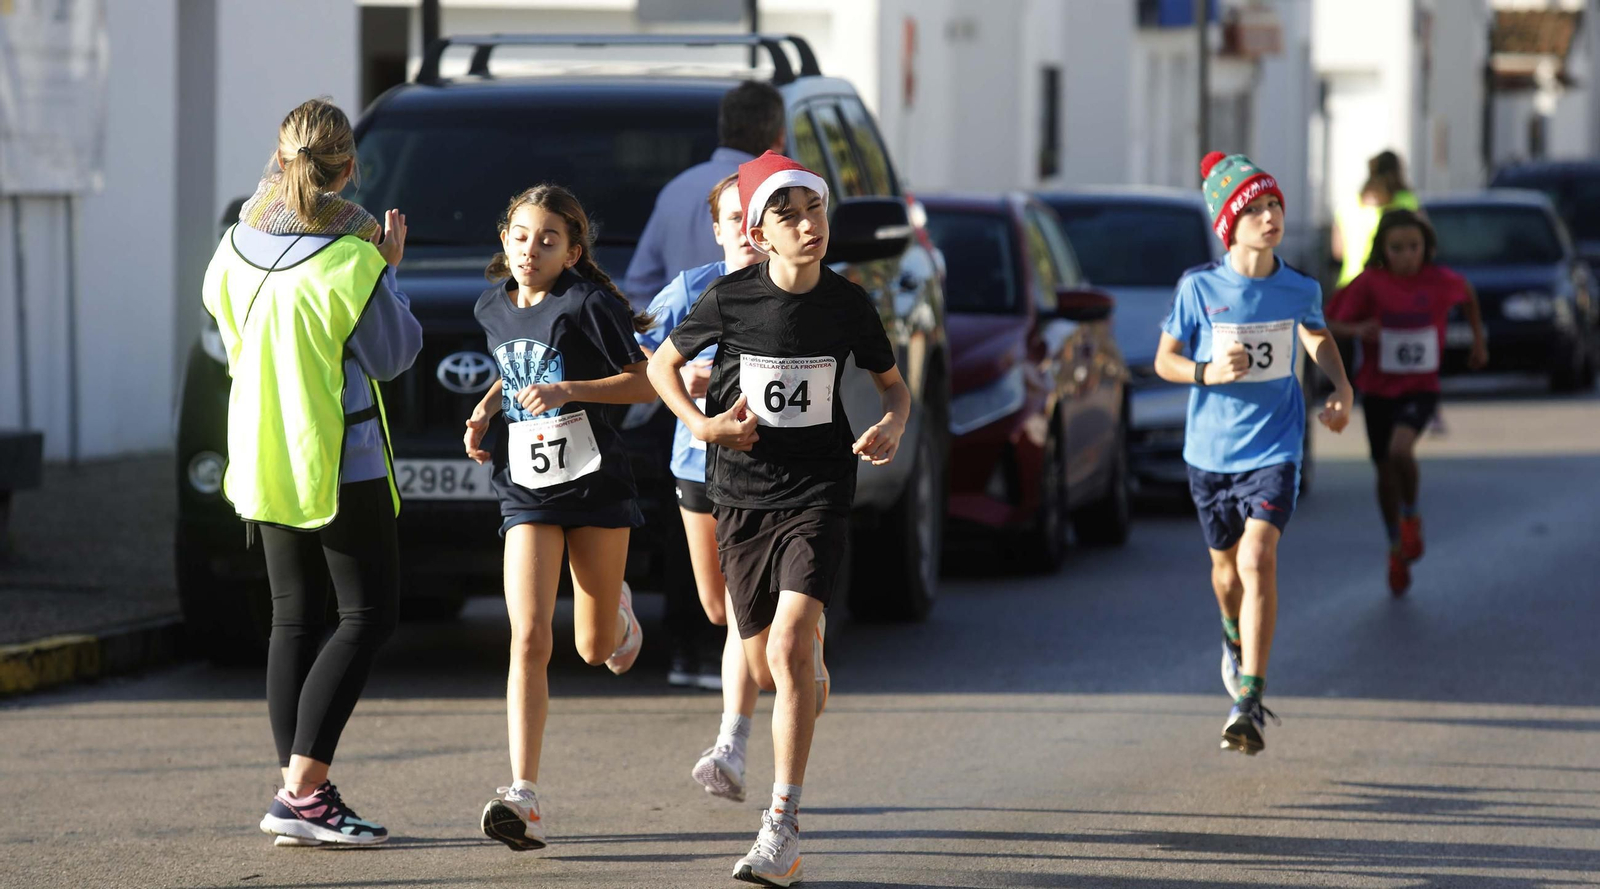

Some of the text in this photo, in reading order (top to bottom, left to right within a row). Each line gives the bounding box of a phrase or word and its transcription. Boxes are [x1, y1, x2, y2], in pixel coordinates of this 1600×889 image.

[502, 350, 538, 360] PRIMARY
[745, 362, 780, 370] CASTELLAR
[1396, 342, 1426, 367] 62
[763, 380, 811, 413] 64
[530, 437, 568, 474] 57
[400, 465, 476, 494] 2984
